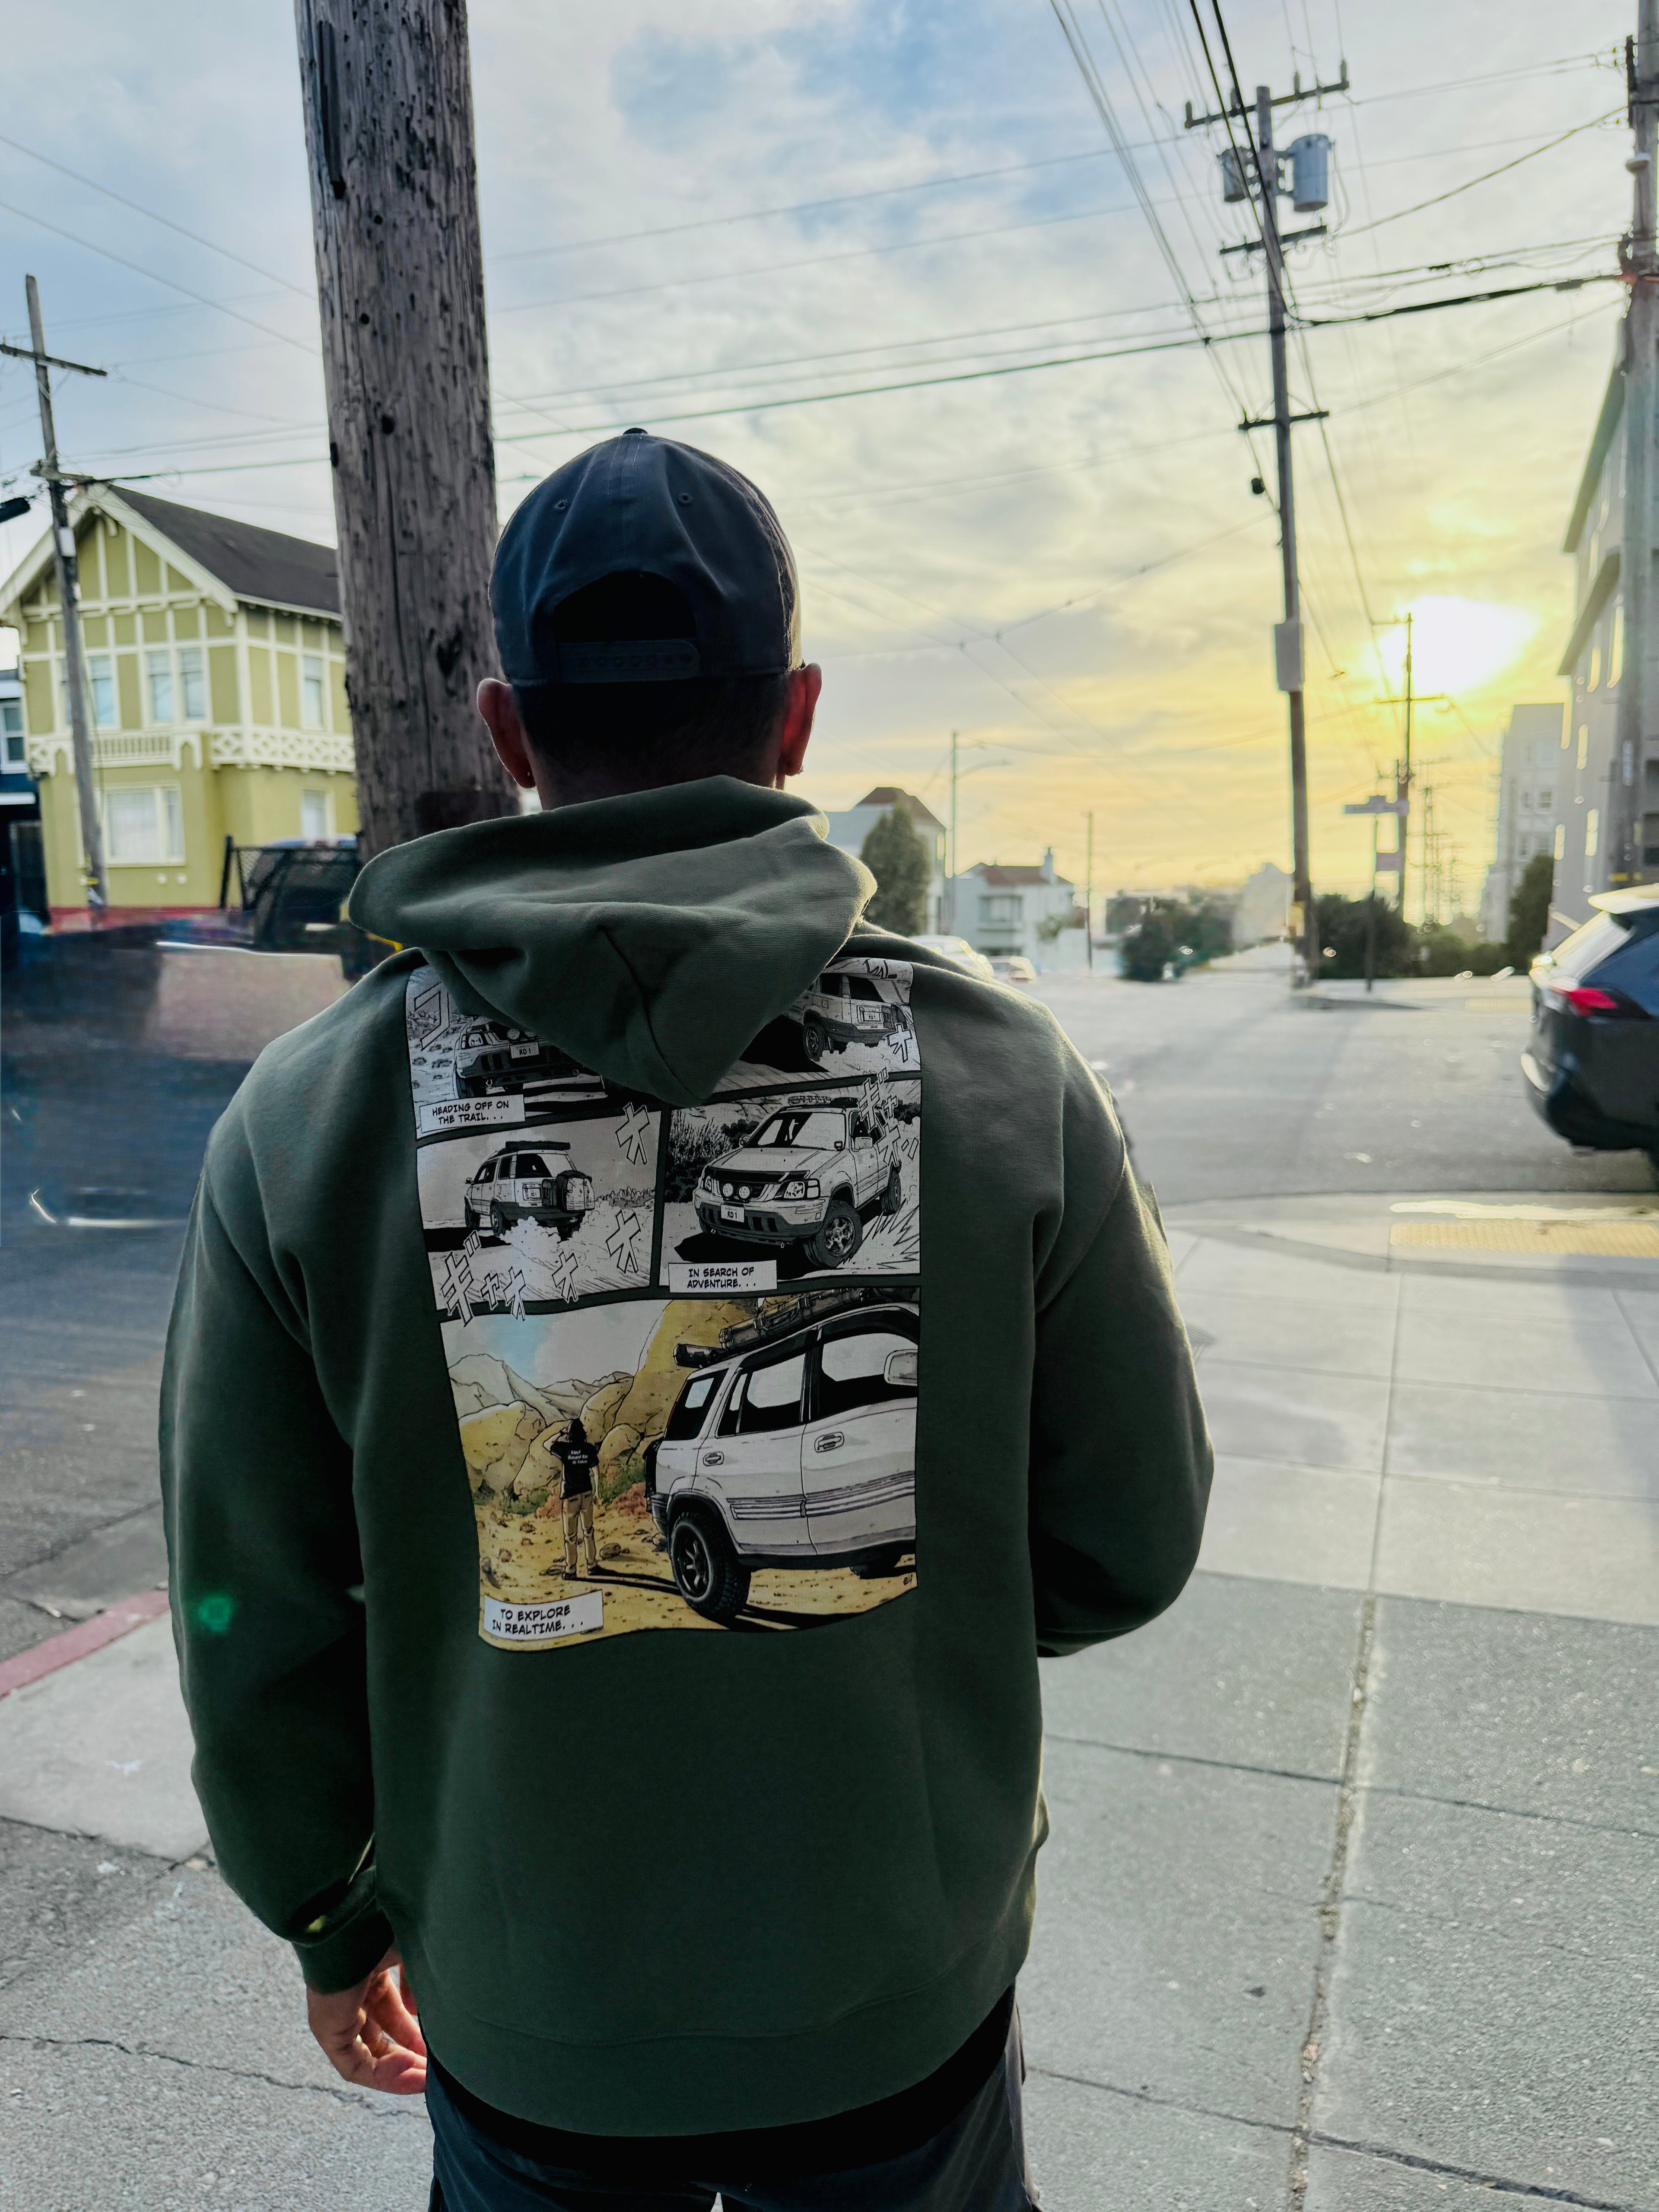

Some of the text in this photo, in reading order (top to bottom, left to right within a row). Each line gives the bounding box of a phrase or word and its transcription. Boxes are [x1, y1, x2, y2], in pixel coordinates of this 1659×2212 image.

[432, 1100, 509, 1116] HEADING OFF ON
[438, 1115, 455, 1125] THE
[689, 1266, 754, 1277] IN SEARCH OF
[501, 1605, 571, 1621] TO EXPLORE
[493, 1619, 502, 1631] IN
